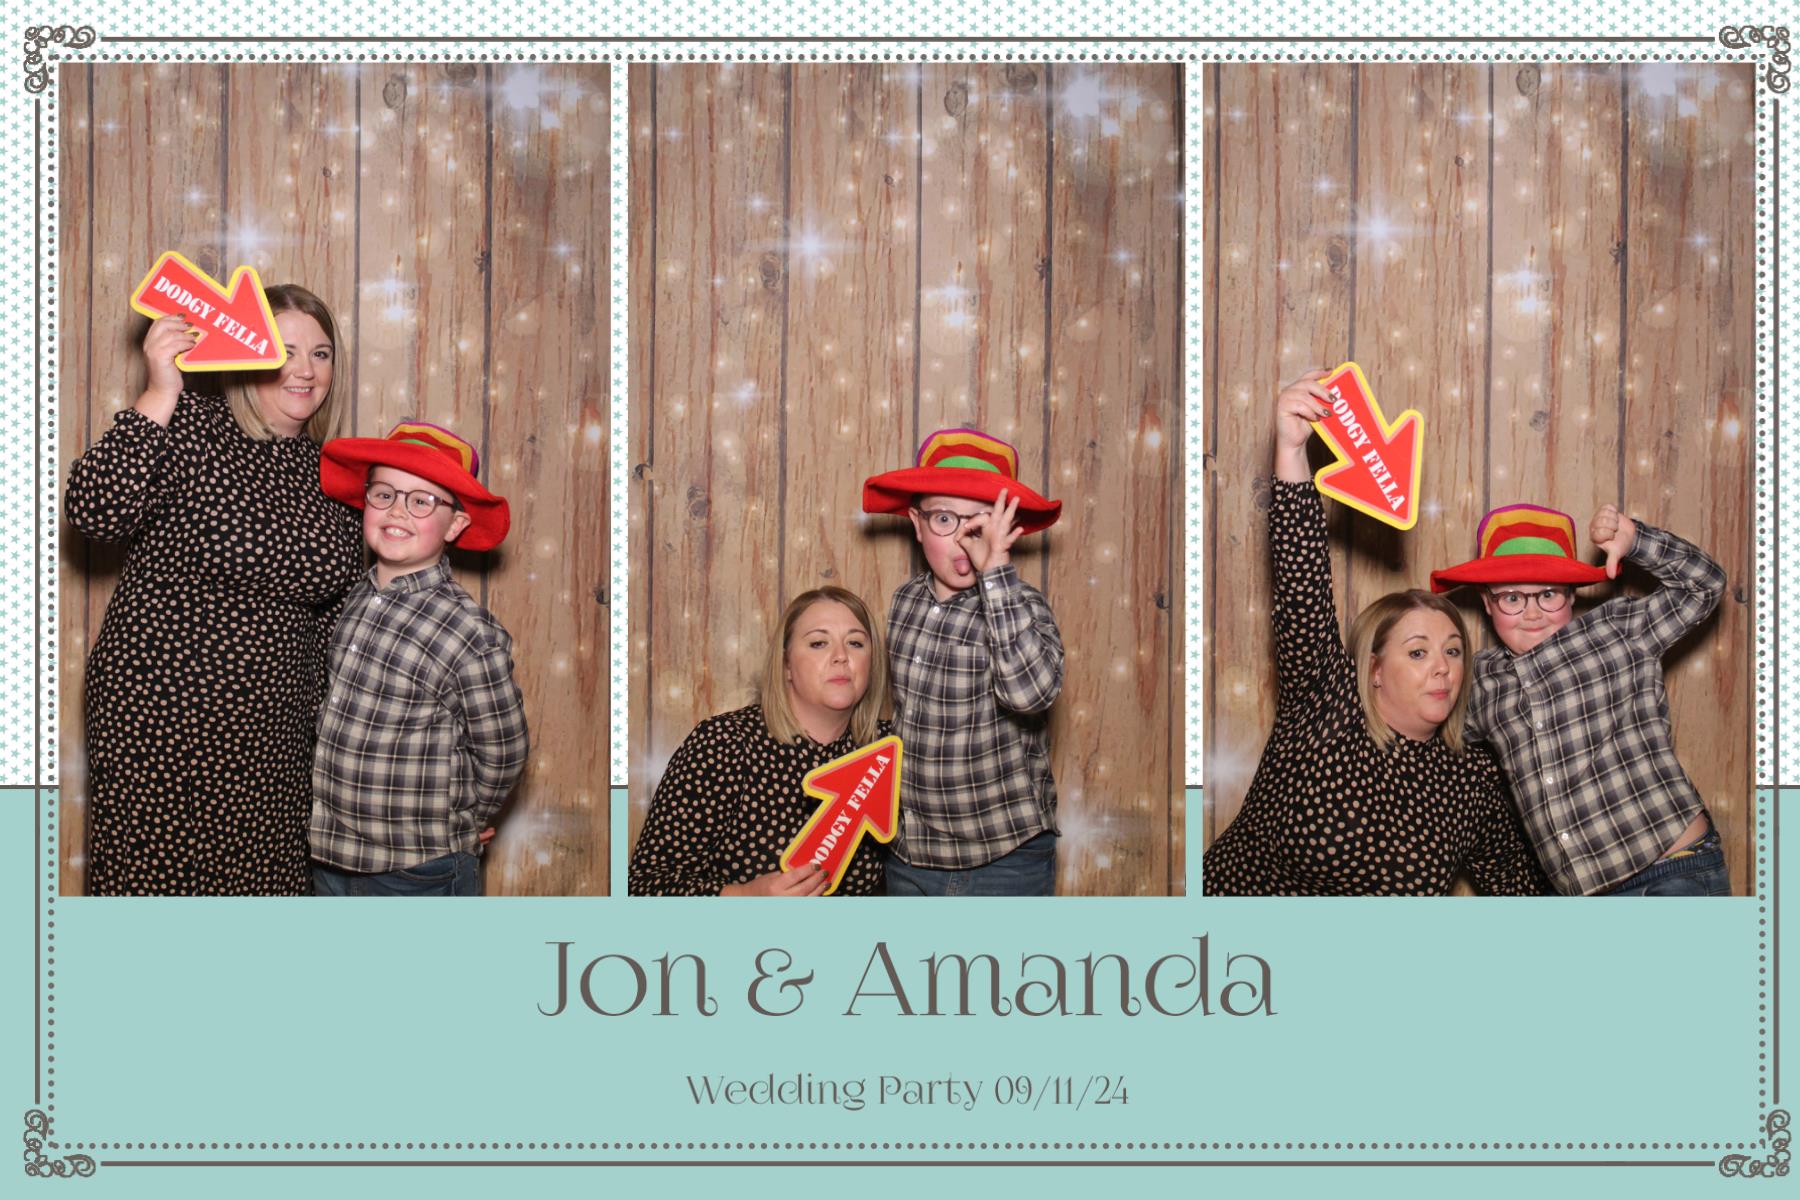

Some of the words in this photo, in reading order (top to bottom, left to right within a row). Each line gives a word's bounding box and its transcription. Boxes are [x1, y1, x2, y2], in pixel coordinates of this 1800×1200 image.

[153, 275, 216, 320] DODGY
[212, 311, 270, 356] FELLA
[1361, 448, 1405, 511] FELLA
[847, 754, 891, 811] FELLA
